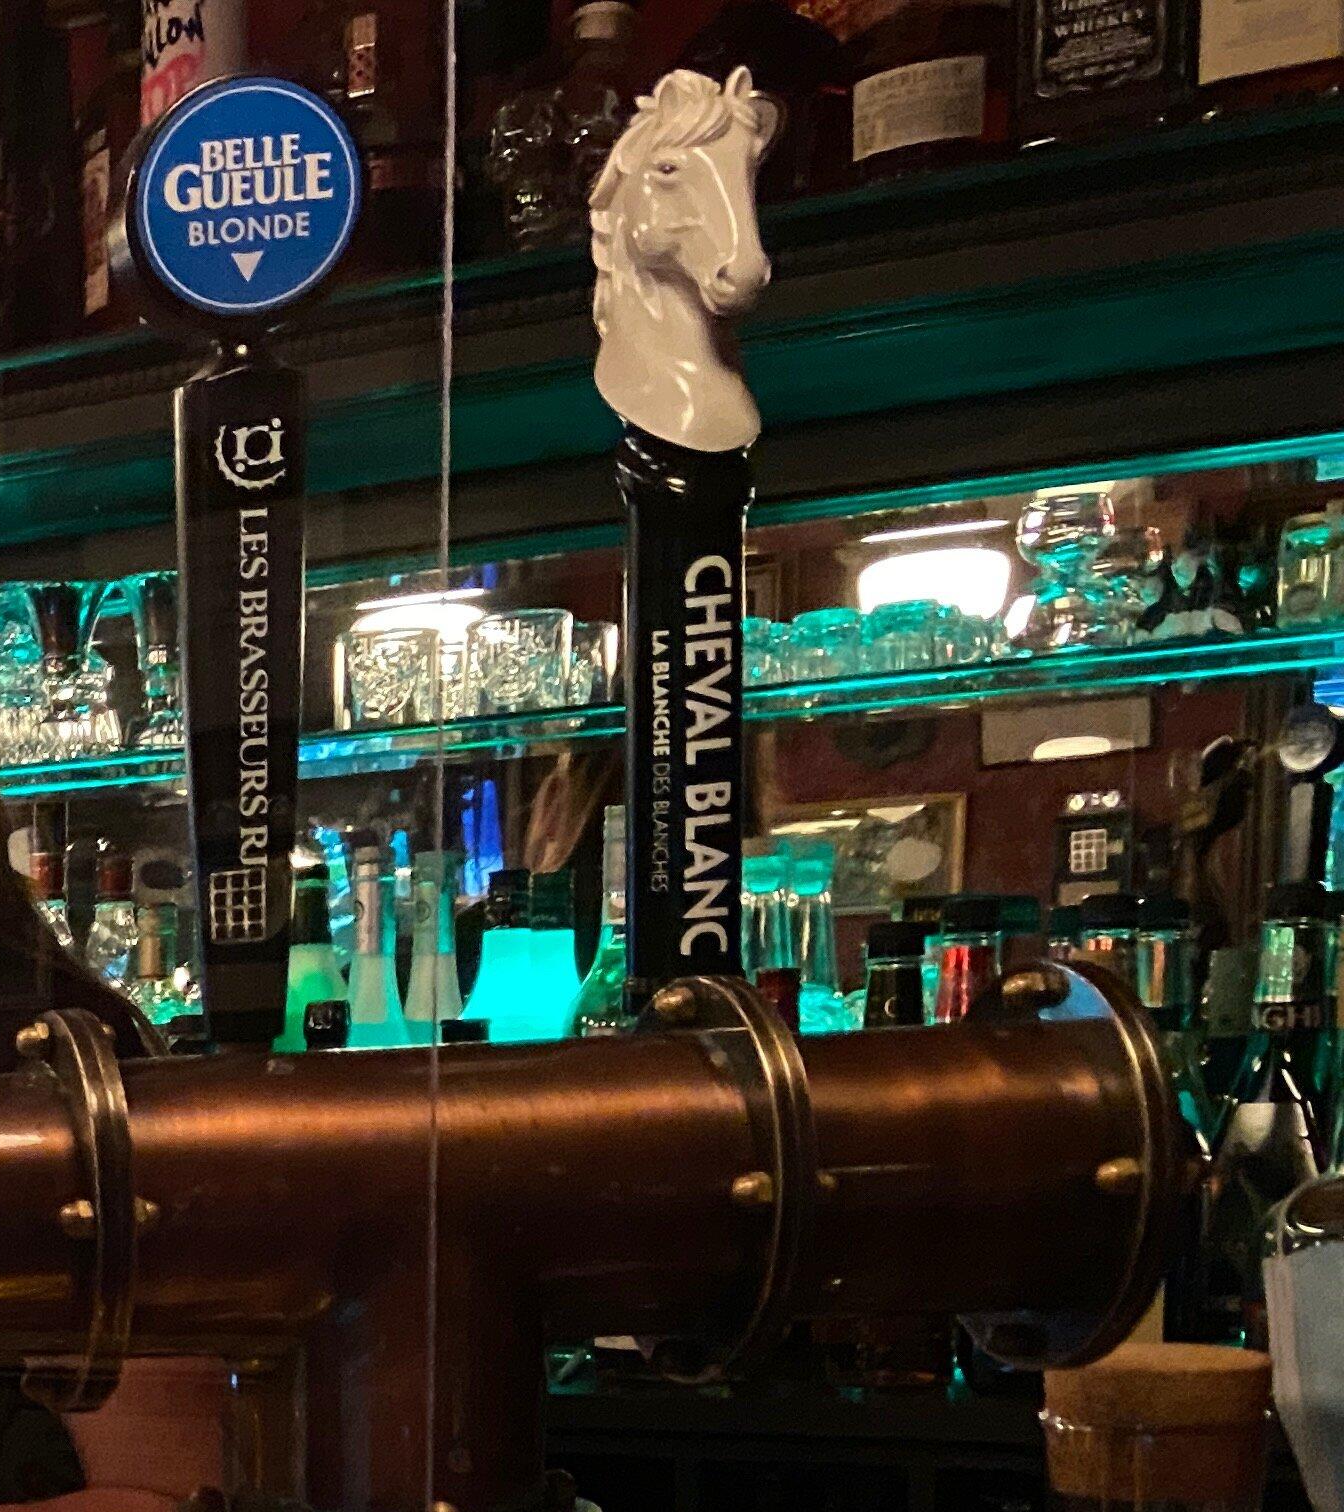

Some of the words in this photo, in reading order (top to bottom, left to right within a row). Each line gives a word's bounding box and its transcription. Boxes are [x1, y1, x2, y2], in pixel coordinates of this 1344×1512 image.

[164, 152, 334, 213] GUEULE
[201, 133, 301, 173] BELLE
[188, 211, 310, 247] BLONDE
[240, 507, 268, 577] LES
[652, 630, 670, 655] LA
[684, 555, 733, 766] CHEVAL
[240, 590, 268, 816] BRASSEURS
[652, 661, 670, 756] BLANCHE
[652, 763, 670, 794] DES
[240, 827, 268, 867] RJ
[651, 800, 670, 891] BLANCHES
[680, 781, 731, 956] BLANC
